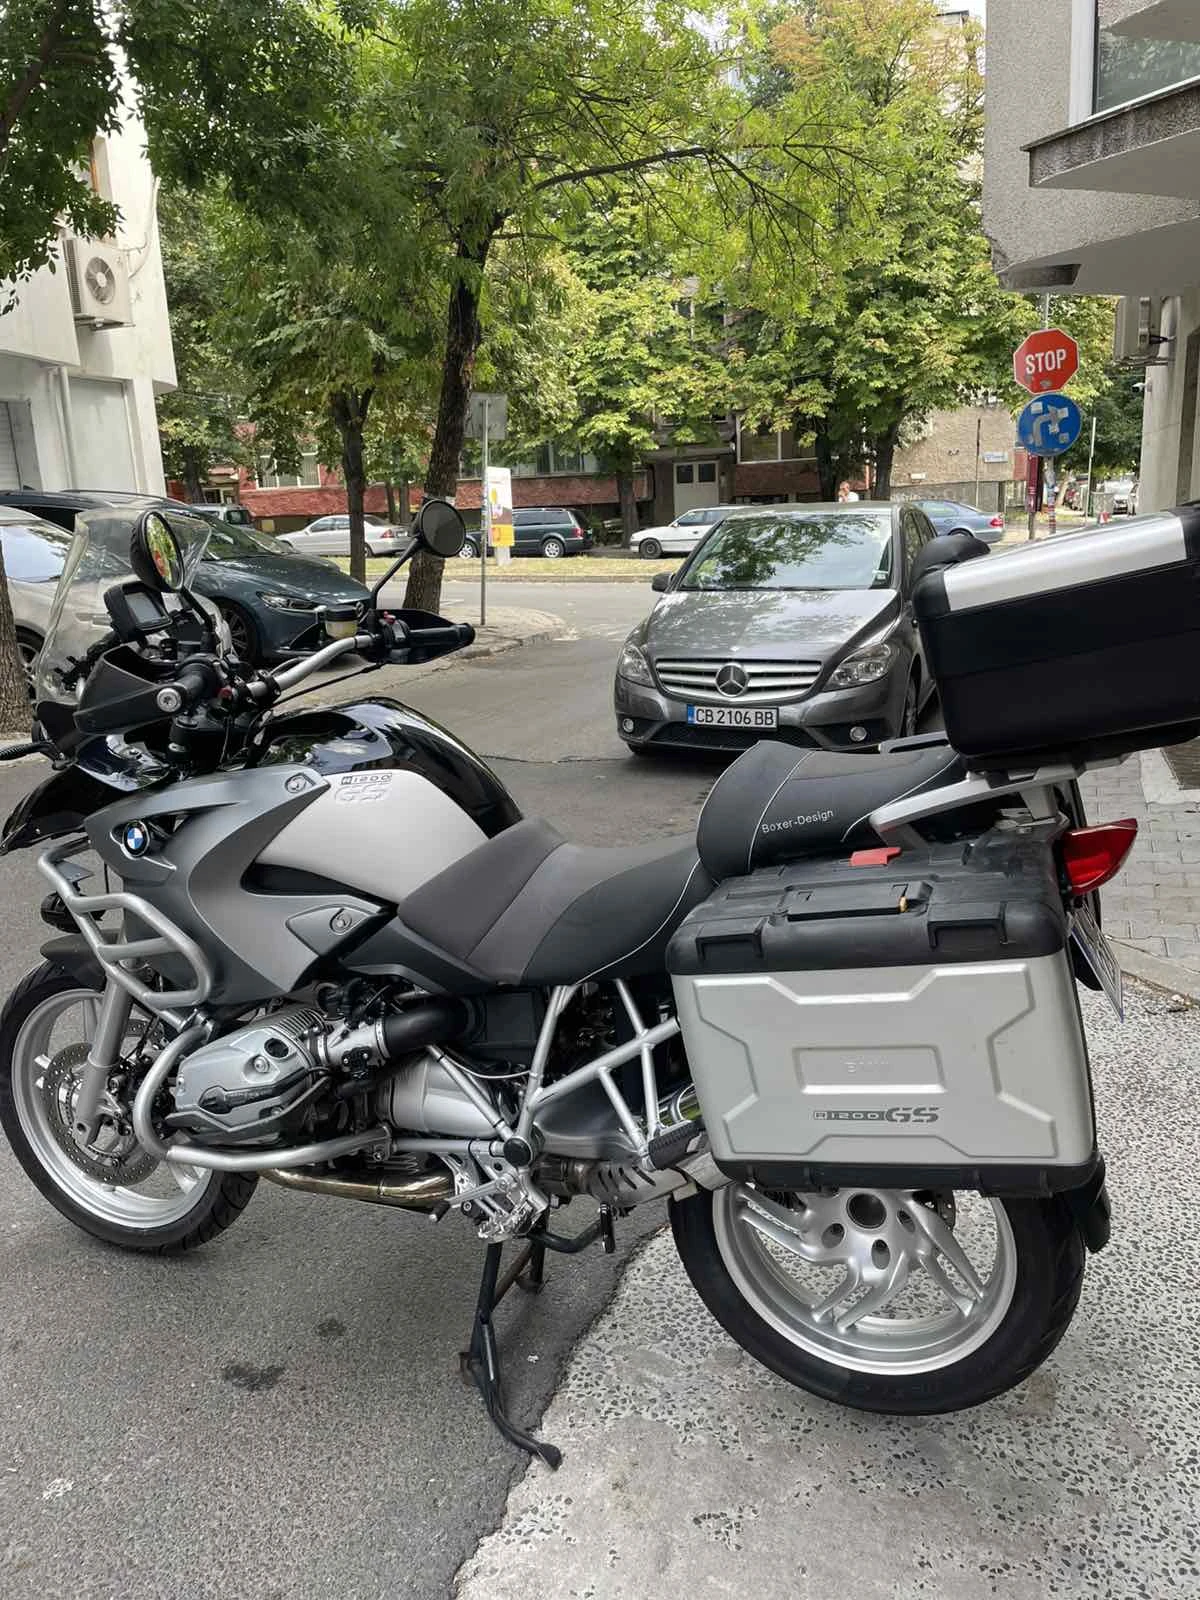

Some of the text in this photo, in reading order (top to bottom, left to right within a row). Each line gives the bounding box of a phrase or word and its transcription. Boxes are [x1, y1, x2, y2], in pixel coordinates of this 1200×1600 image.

[1024, 348, 1067, 375] STOP
[695, 708, 774, 726] CB 2106 BB
[761, 809, 834, 833] Boxer-Design
